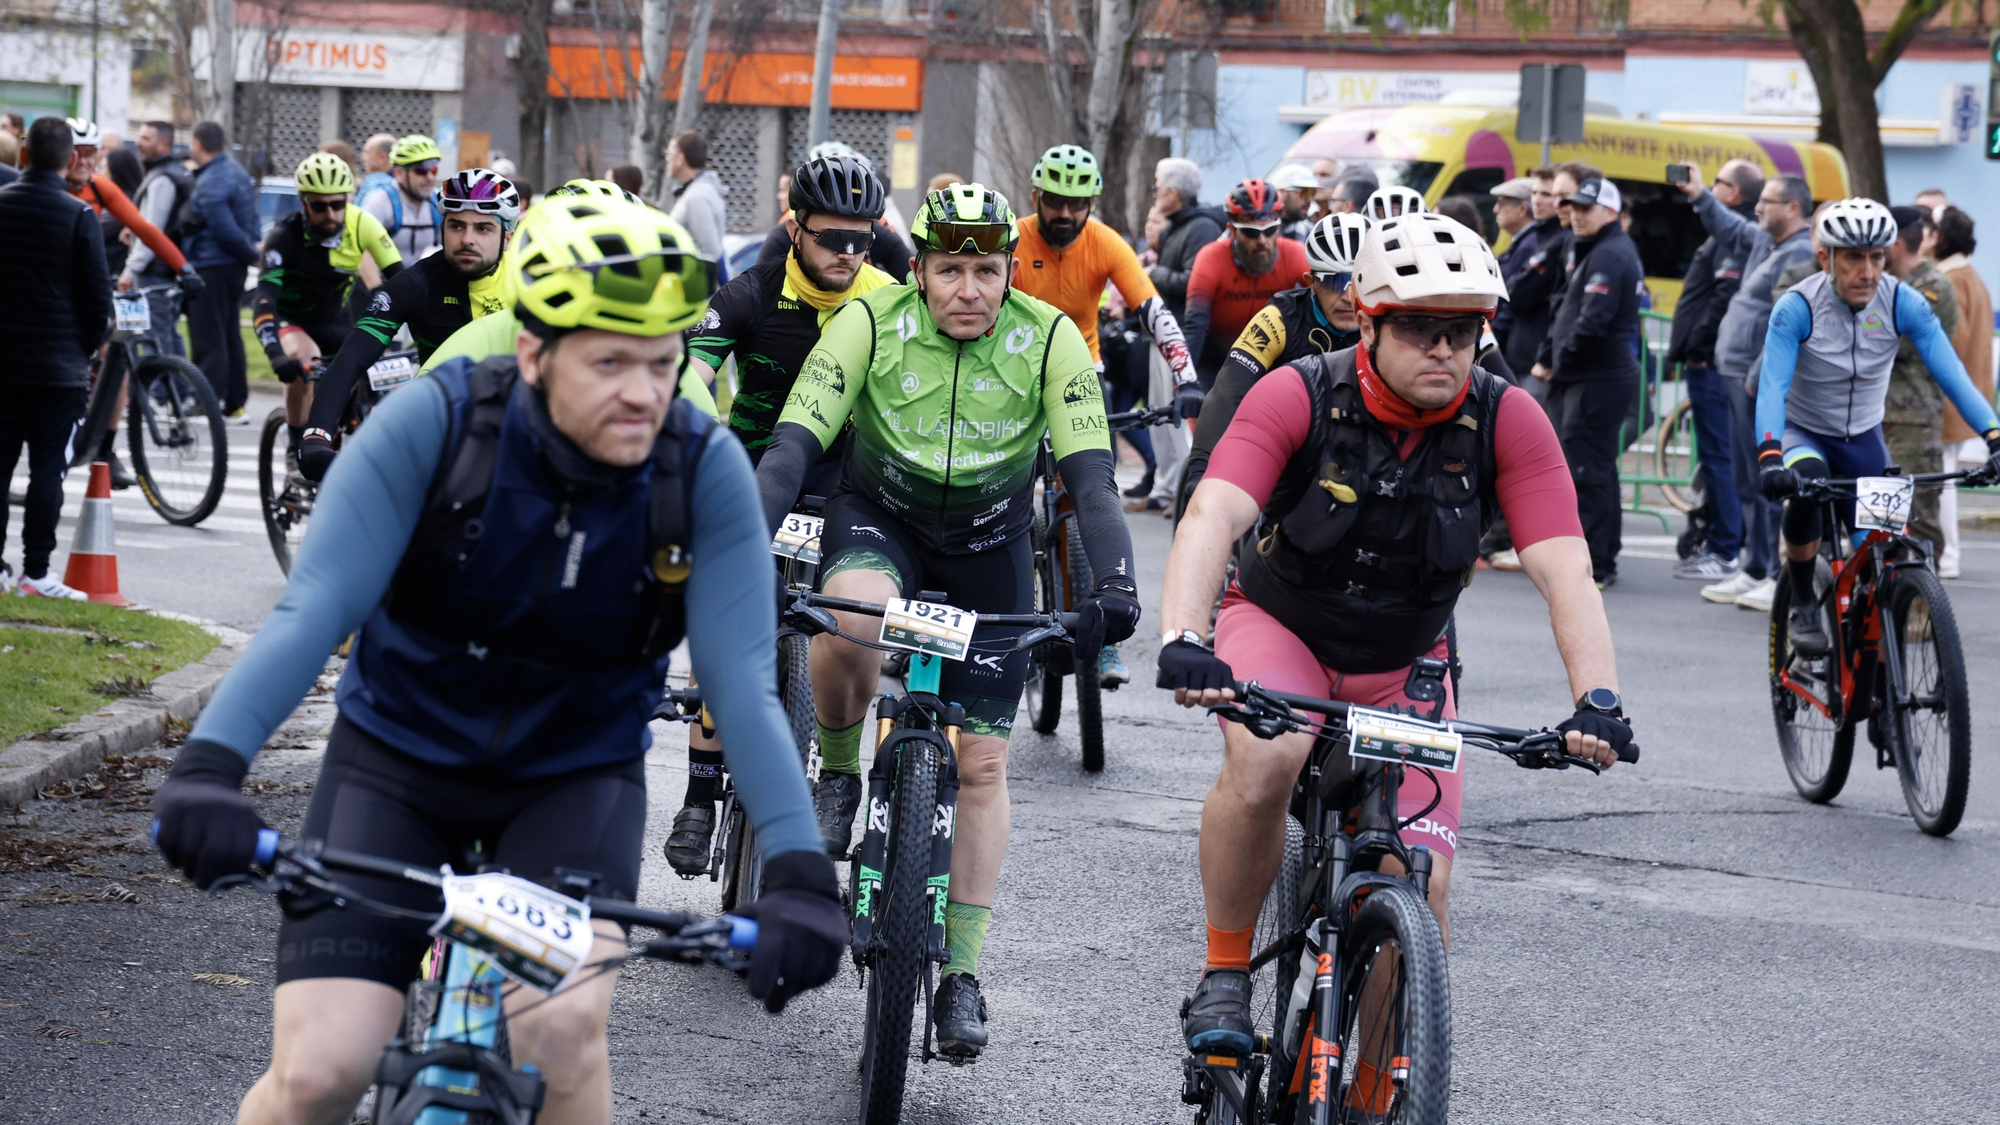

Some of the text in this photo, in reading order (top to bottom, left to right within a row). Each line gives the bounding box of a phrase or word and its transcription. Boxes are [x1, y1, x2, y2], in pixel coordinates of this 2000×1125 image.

[266, 37, 388, 70] OPTIMUS
[1338, 75, 1379, 102] RV
[1229, 350, 1260, 374] Guerin
[931, 450, 1006, 471] SportLab
[878, 485, 910, 511] Francisco
[1870, 492, 1901, 510] 293
[900, 599, 963, 628] 1921
[936, 638, 963, 651] Smilke
[1421, 748, 1454, 762] Smilke
[867, 796, 890, 834] 32
[931, 803, 954, 839] 32
[855, 880, 872, 918] FOX
[933, 887, 949, 926] FOX
[476, 894, 573, 941] 683
[1308, 1055, 1329, 1105] FOX
